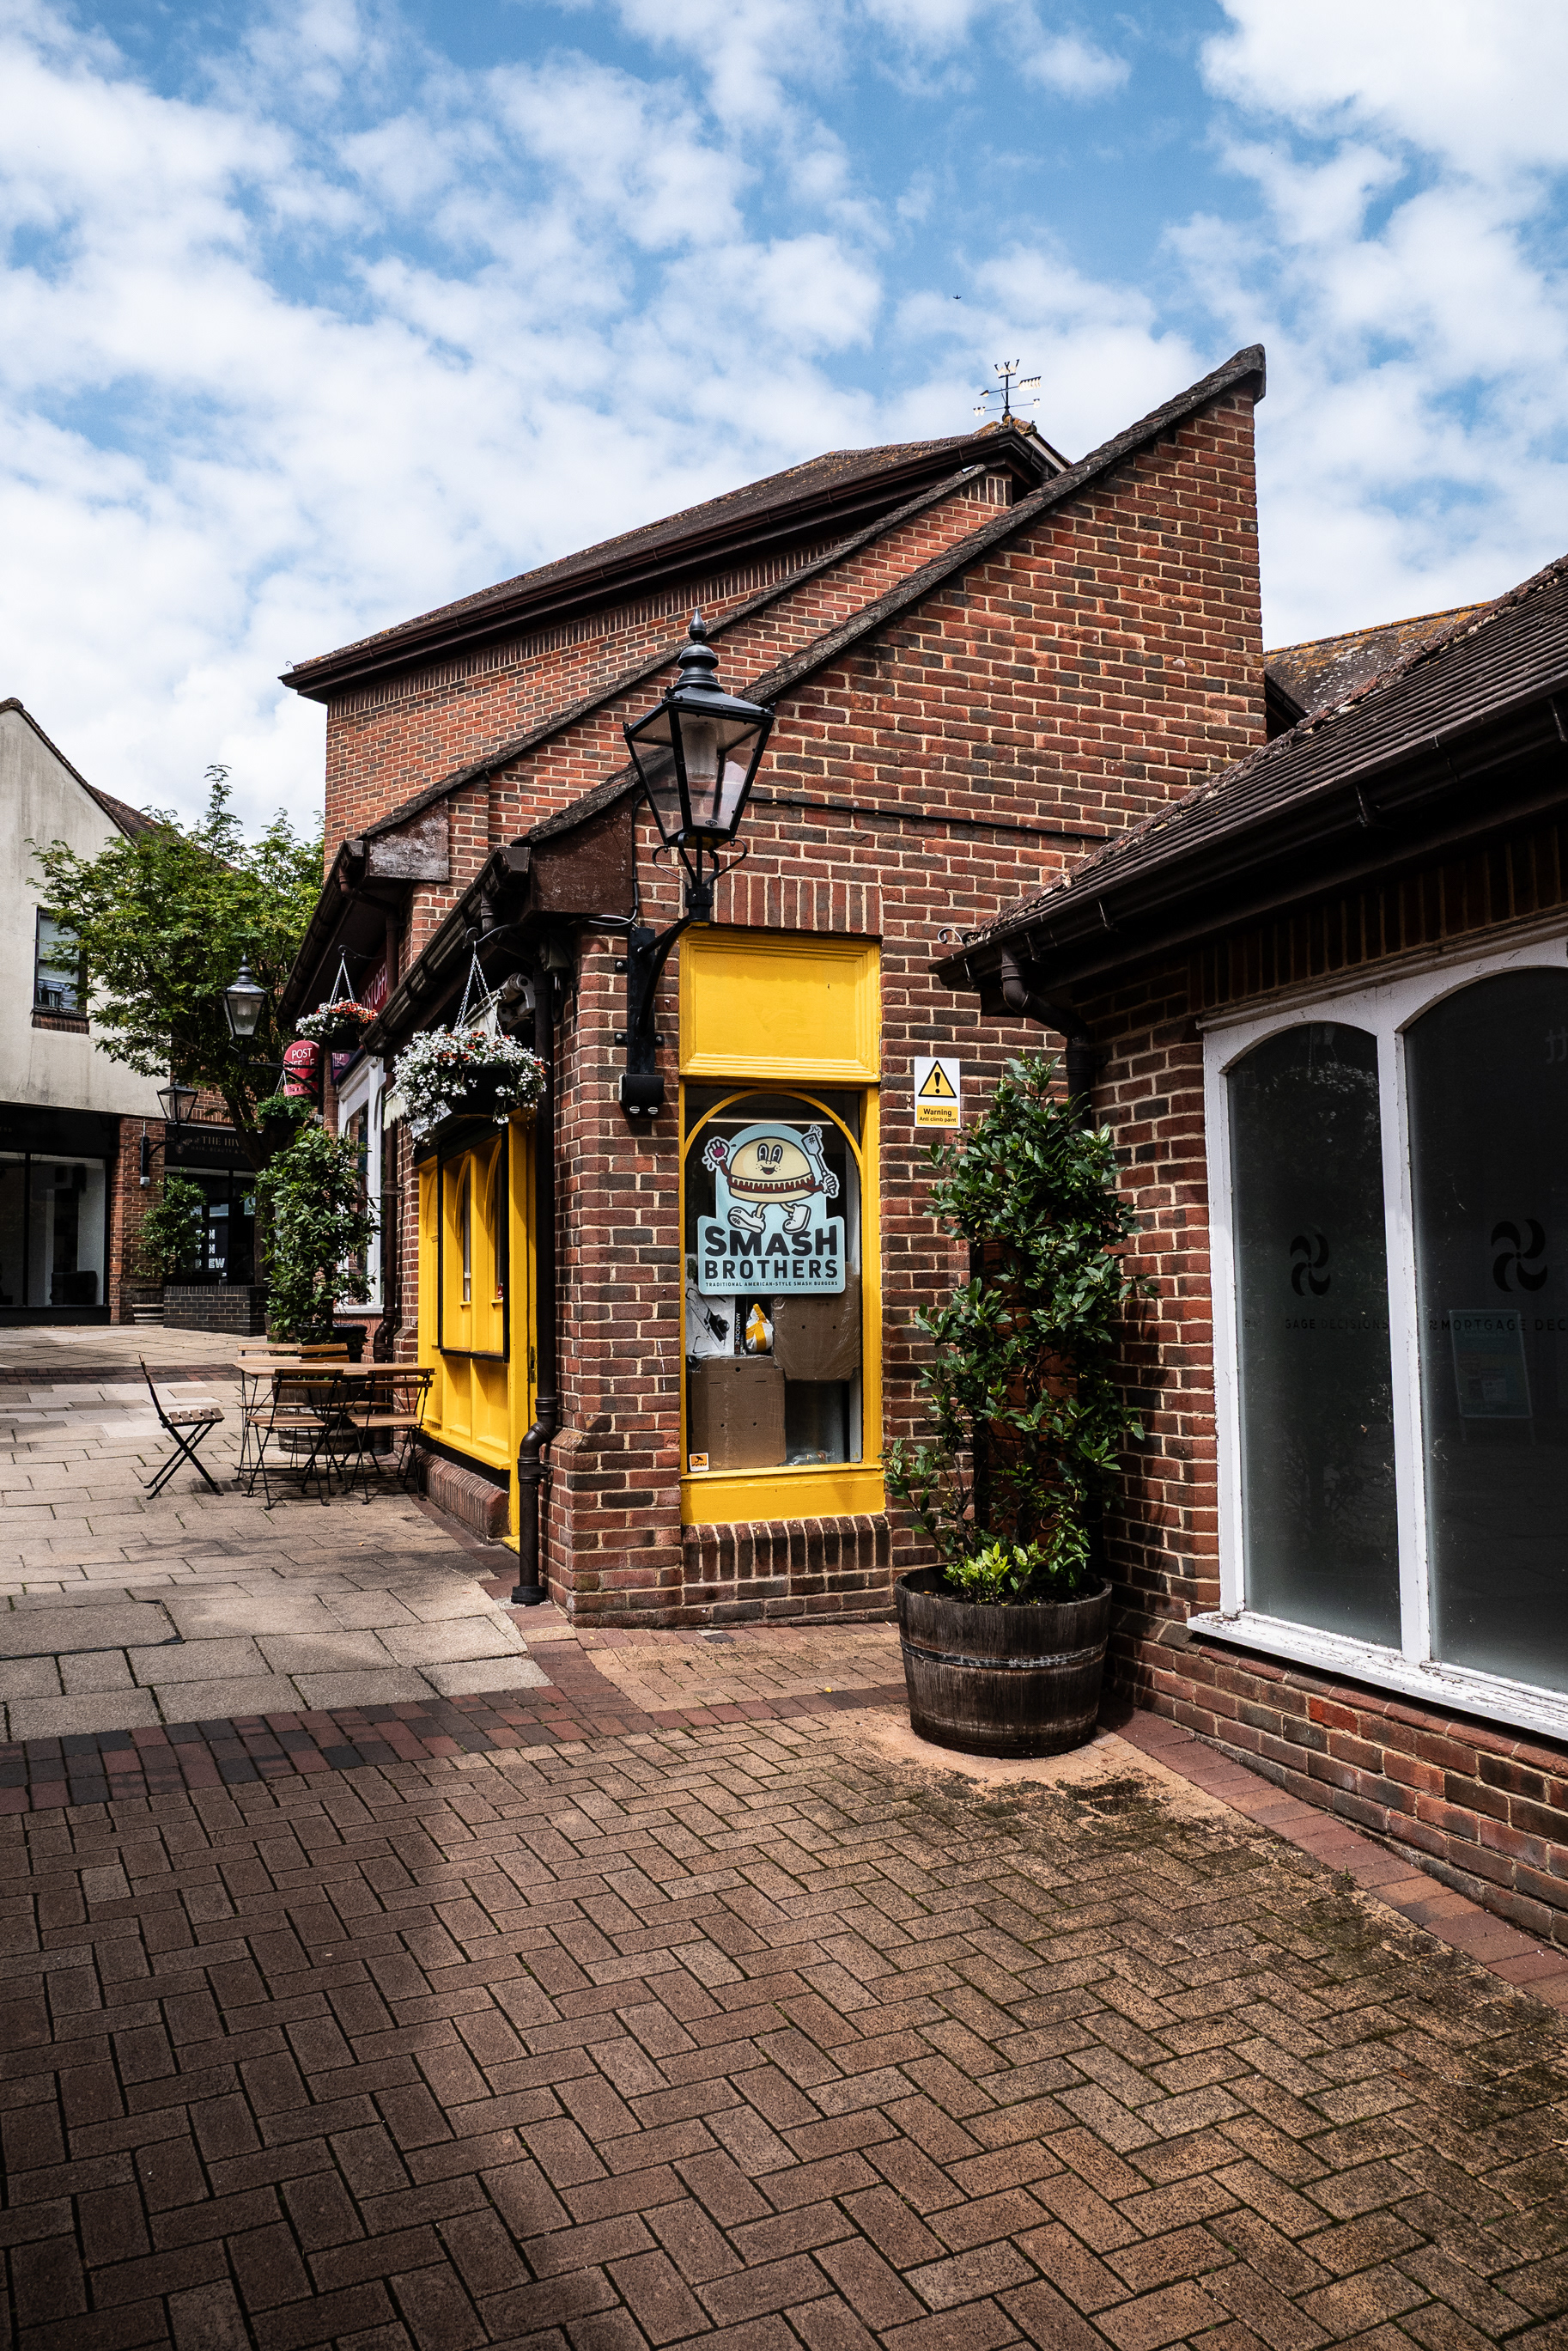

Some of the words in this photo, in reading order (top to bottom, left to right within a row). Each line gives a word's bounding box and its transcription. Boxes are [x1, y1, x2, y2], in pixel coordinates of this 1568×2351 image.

[292, 1048, 313, 1059] POST
[287, 1058, 315, 1071] OFFE
[923, 1108, 952, 1117] Warning
[201, 1136, 222, 1146] THE
[224, 1137, 240, 1148] HIV
[705, 1224, 837, 1257] SMASH
[195, 1258, 226, 1269] BEW
[705, 1259, 838, 1279] BROTHERS
[1321, 1319, 1389, 1330] DECISIONS
[1441, 1319, 1527, 1331] MORTGAGE
[1535, 1319, 1566, 1331] DEC
